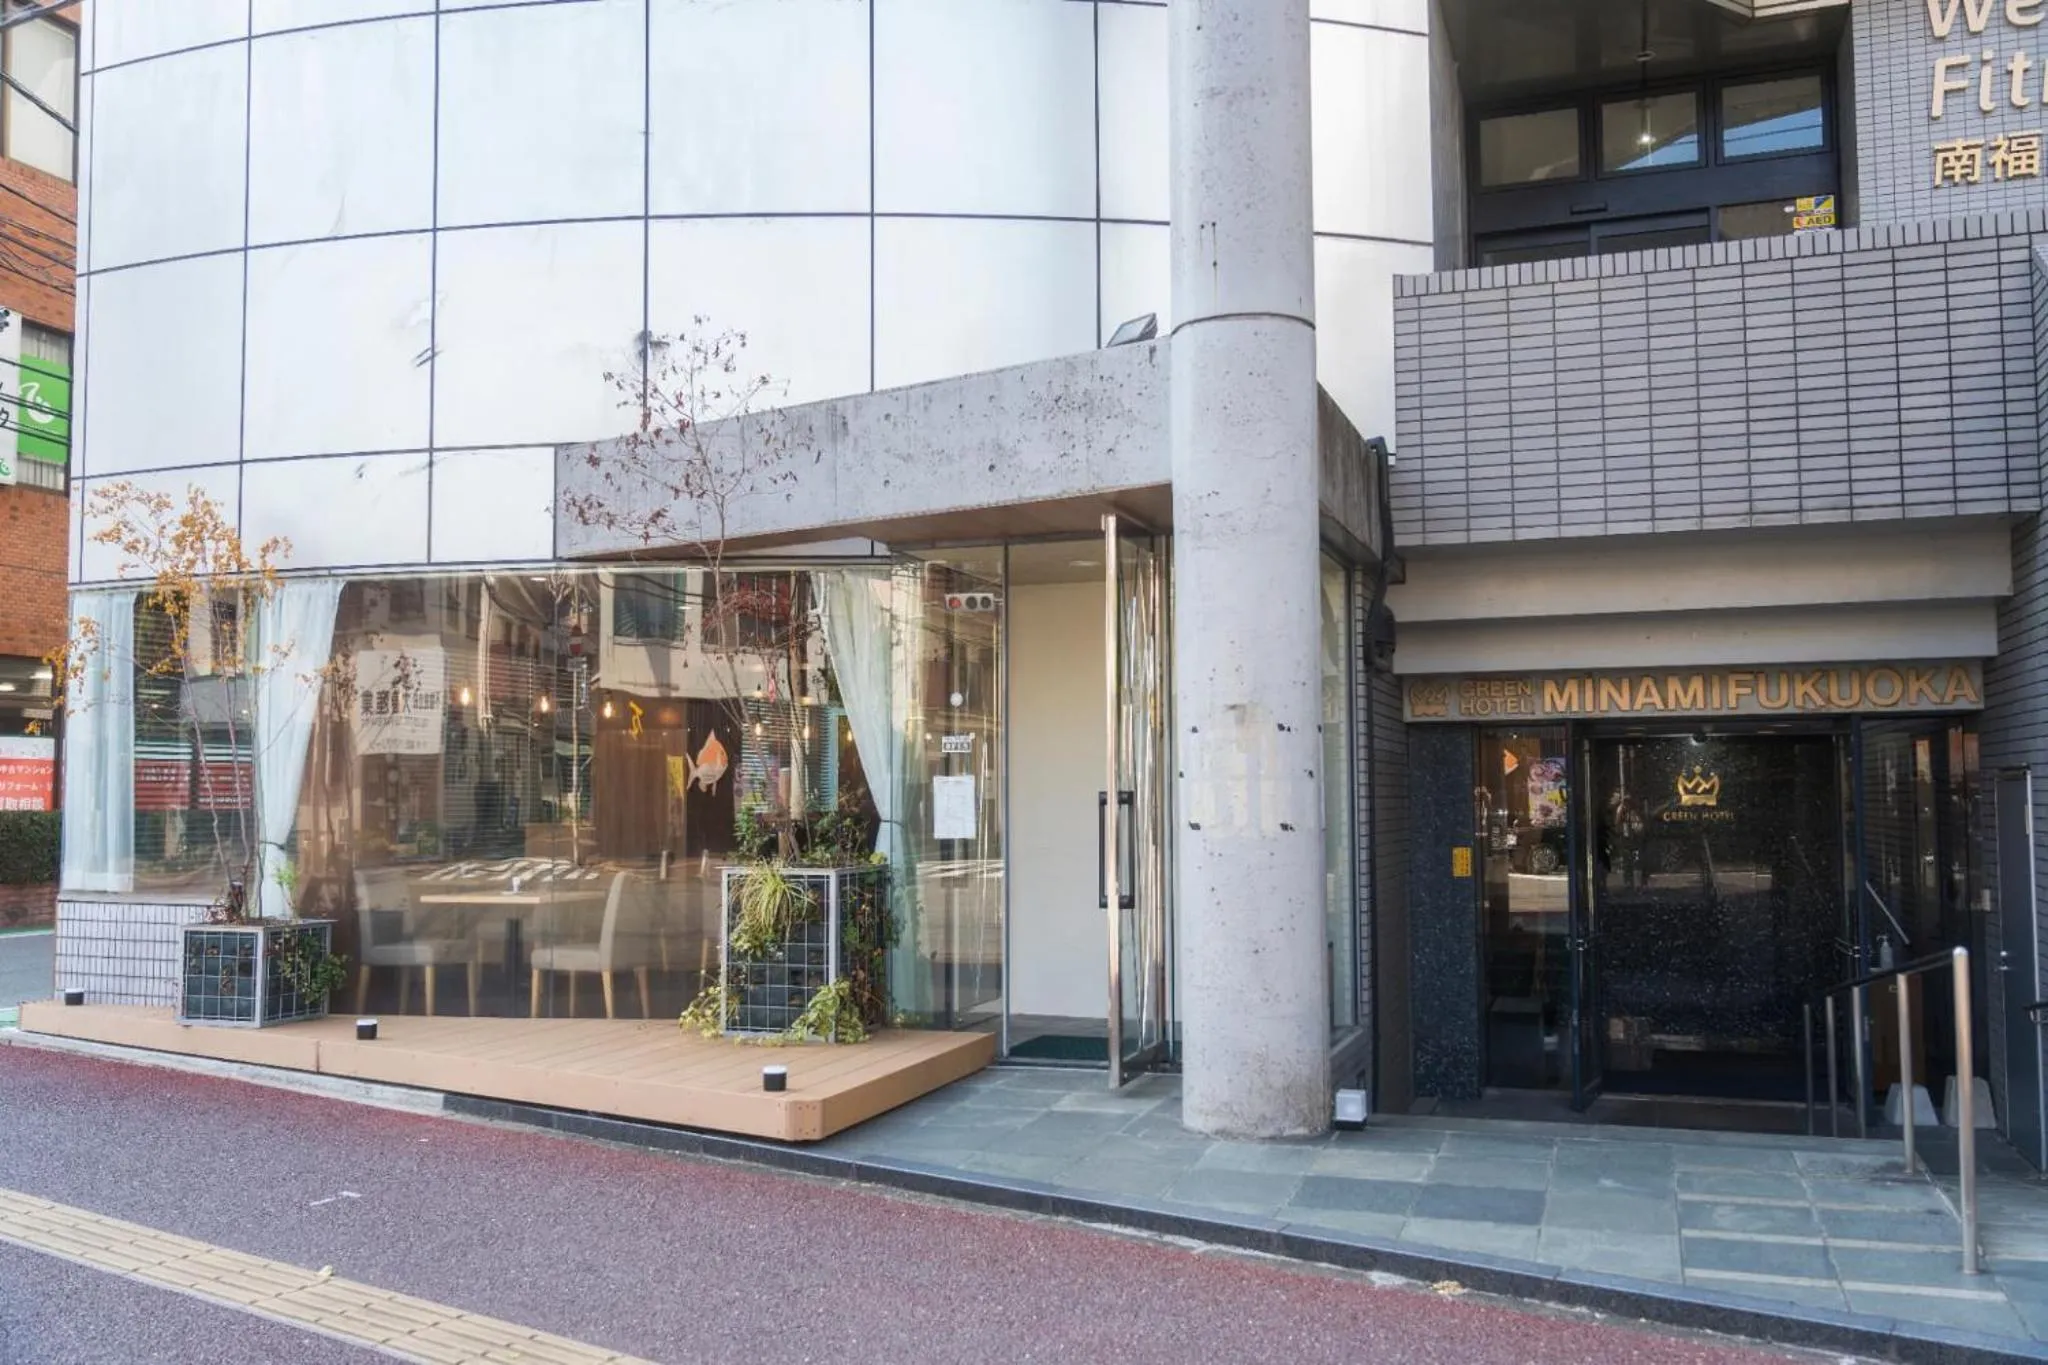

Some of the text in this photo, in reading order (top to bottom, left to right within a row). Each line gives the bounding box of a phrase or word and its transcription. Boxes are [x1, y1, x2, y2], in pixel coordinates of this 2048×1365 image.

[1930, 49, 2048, 120] Fit
[1933, 129, 2043, 188] 南福
[1806, 214, 1833, 226] AED
[1459, 680, 1533, 698] GREEN
[1541, 664, 1981, 714] MINAMIFUKUOKA
[1459, 697, 1535, 716] HOTEL
